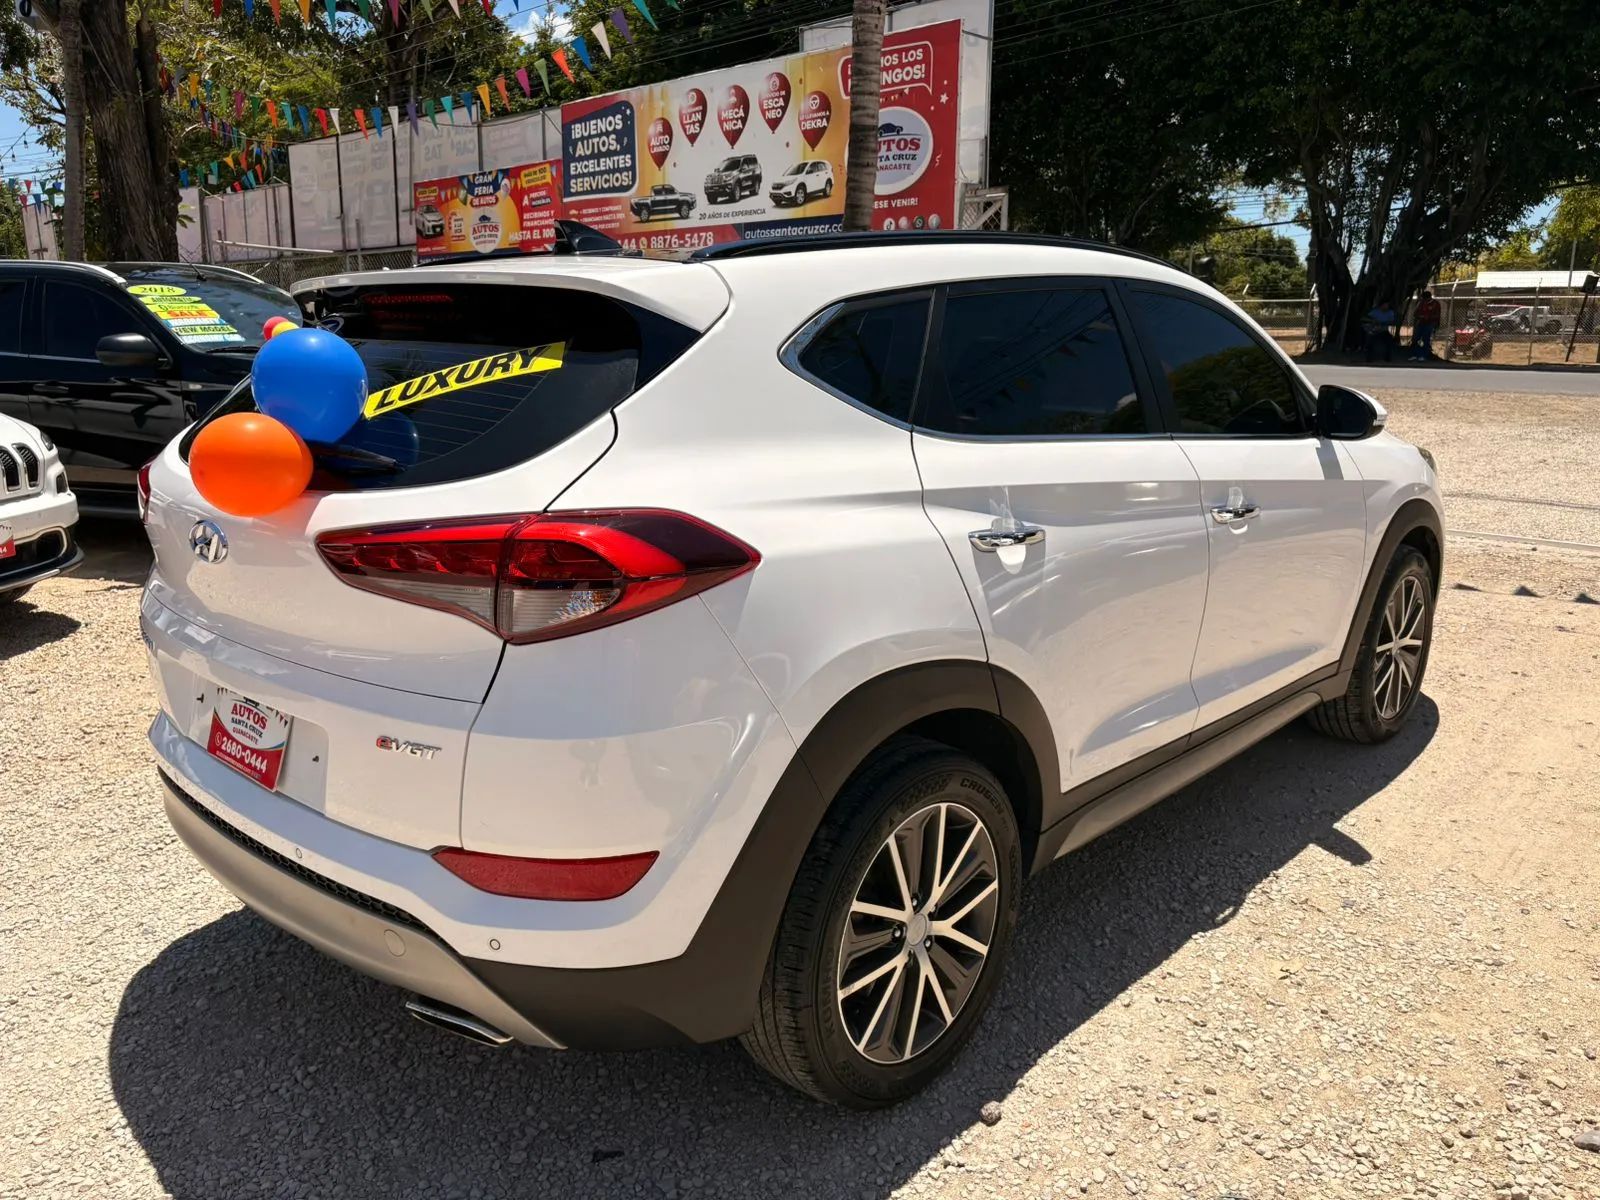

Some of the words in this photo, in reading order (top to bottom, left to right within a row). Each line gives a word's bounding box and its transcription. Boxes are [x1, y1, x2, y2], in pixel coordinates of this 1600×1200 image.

[902, 49, 923, 63] LOS
[762, 97, 785, 110] ESCA
[682, 111, 702, 124] LLAN
[721, 105, 745, 121] MECÁ
[765, 109, 783, 120] NEO
[571, 114, 623, 139] ¡BUENOS
[685, 123, 700, 136] TAS
[722, 121, 743, 132] NICA
[801, 118, 828, 131] DEKRA
[575, 134, 620, 157] AUTOS,
[651, 135, 670, 146] AUTO
[892, 153, 917, 161] CRUZ
[570, 154, 632, 176] EXCELENTES
[877, 163, 912, 171] NACASTE
[474, 174, 493, 184] GRAN
[570, 171, 632, 193] SERVICIOS!
[474, 185, 495, 196] FERIA
[891, 197, 919, 207] VENIR!
[698, 213, 707, 221] 20
[707, 211, 723, 220] AÑOS
[731, 208, 767, 218] EXPERIENCIA
[471, 224, 500, 236] AUTOS
[508, 230, 532, 242] HASTA
[533, 229, 541, 239] EL
[650, 232, 714, 249] 8876-5478
[139, 286, 176, 294] 2018
[167, 310, 209, 318] SALE
[199, 325, 233, 333] MODEL
[373, 344, 552, 412] LUXURY
[231, 703, 268, 730] AUTOS
[231, 717, 249, 729] SANTA
[221, 737, 268, 773] 2680-0444
